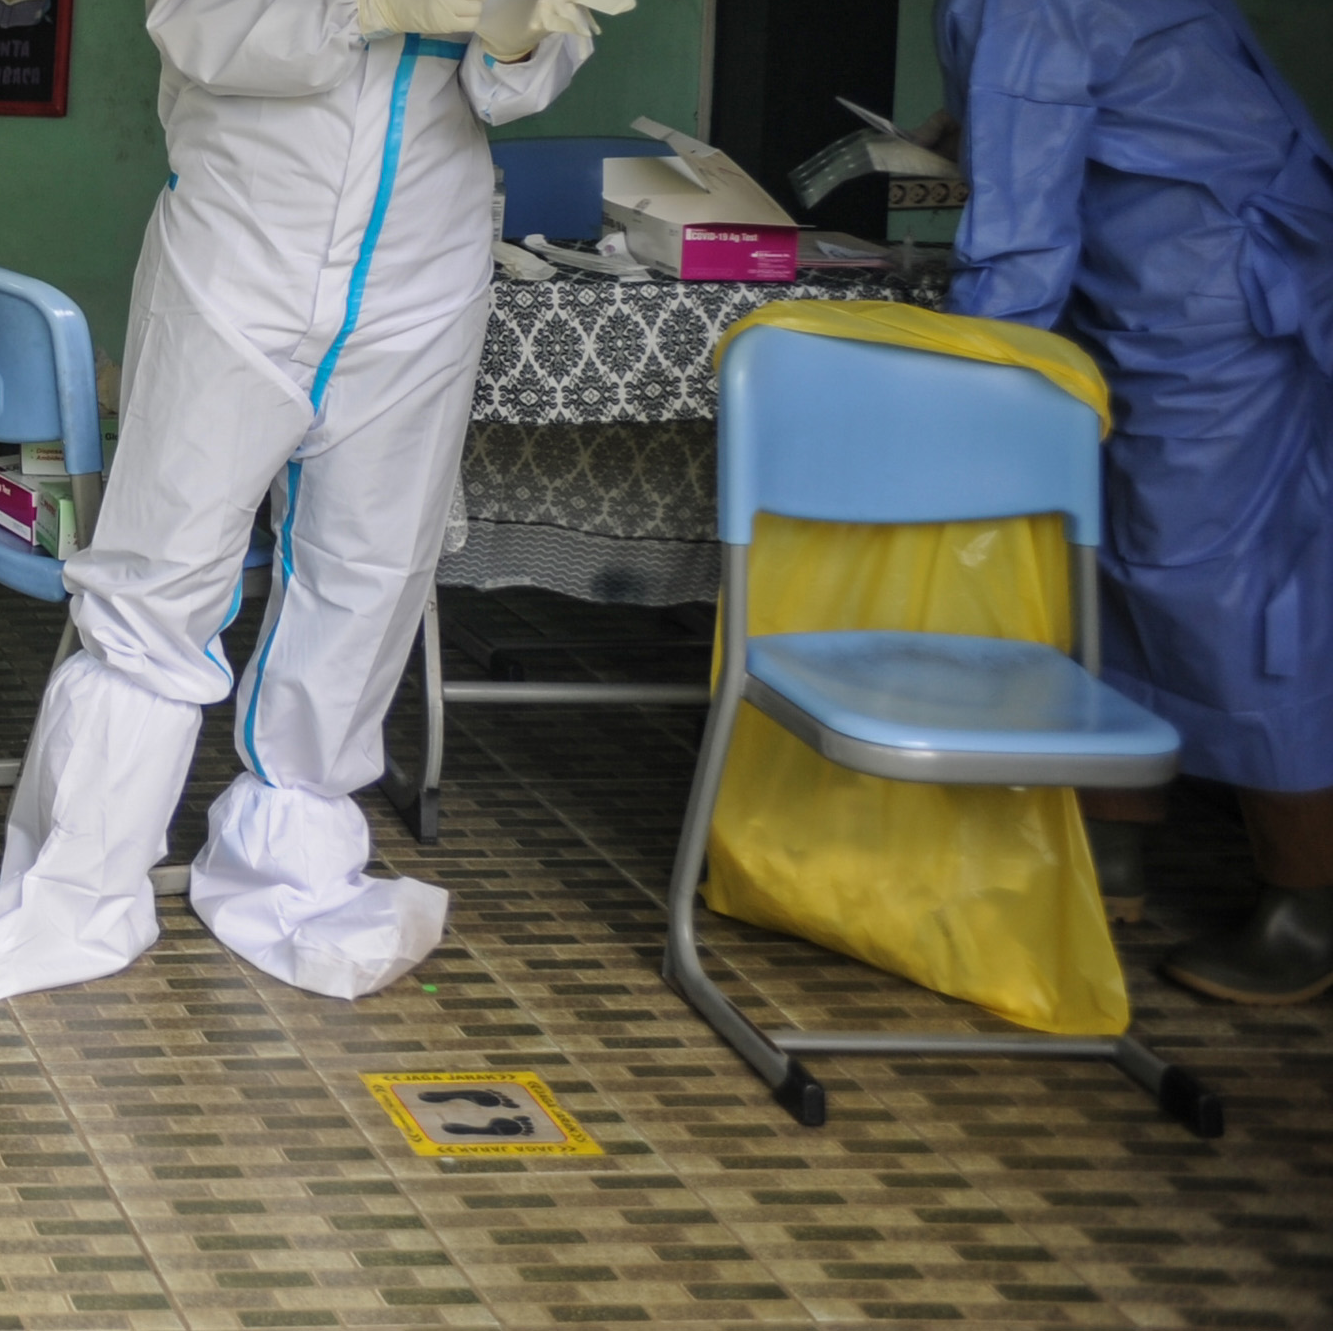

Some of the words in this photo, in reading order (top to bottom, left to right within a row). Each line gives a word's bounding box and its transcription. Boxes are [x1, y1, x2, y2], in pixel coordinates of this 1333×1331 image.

[691, 232, 728, 241] COVID-19
[729, 233, 740, 243] Ag
[742, 233, 758, 241] Test
